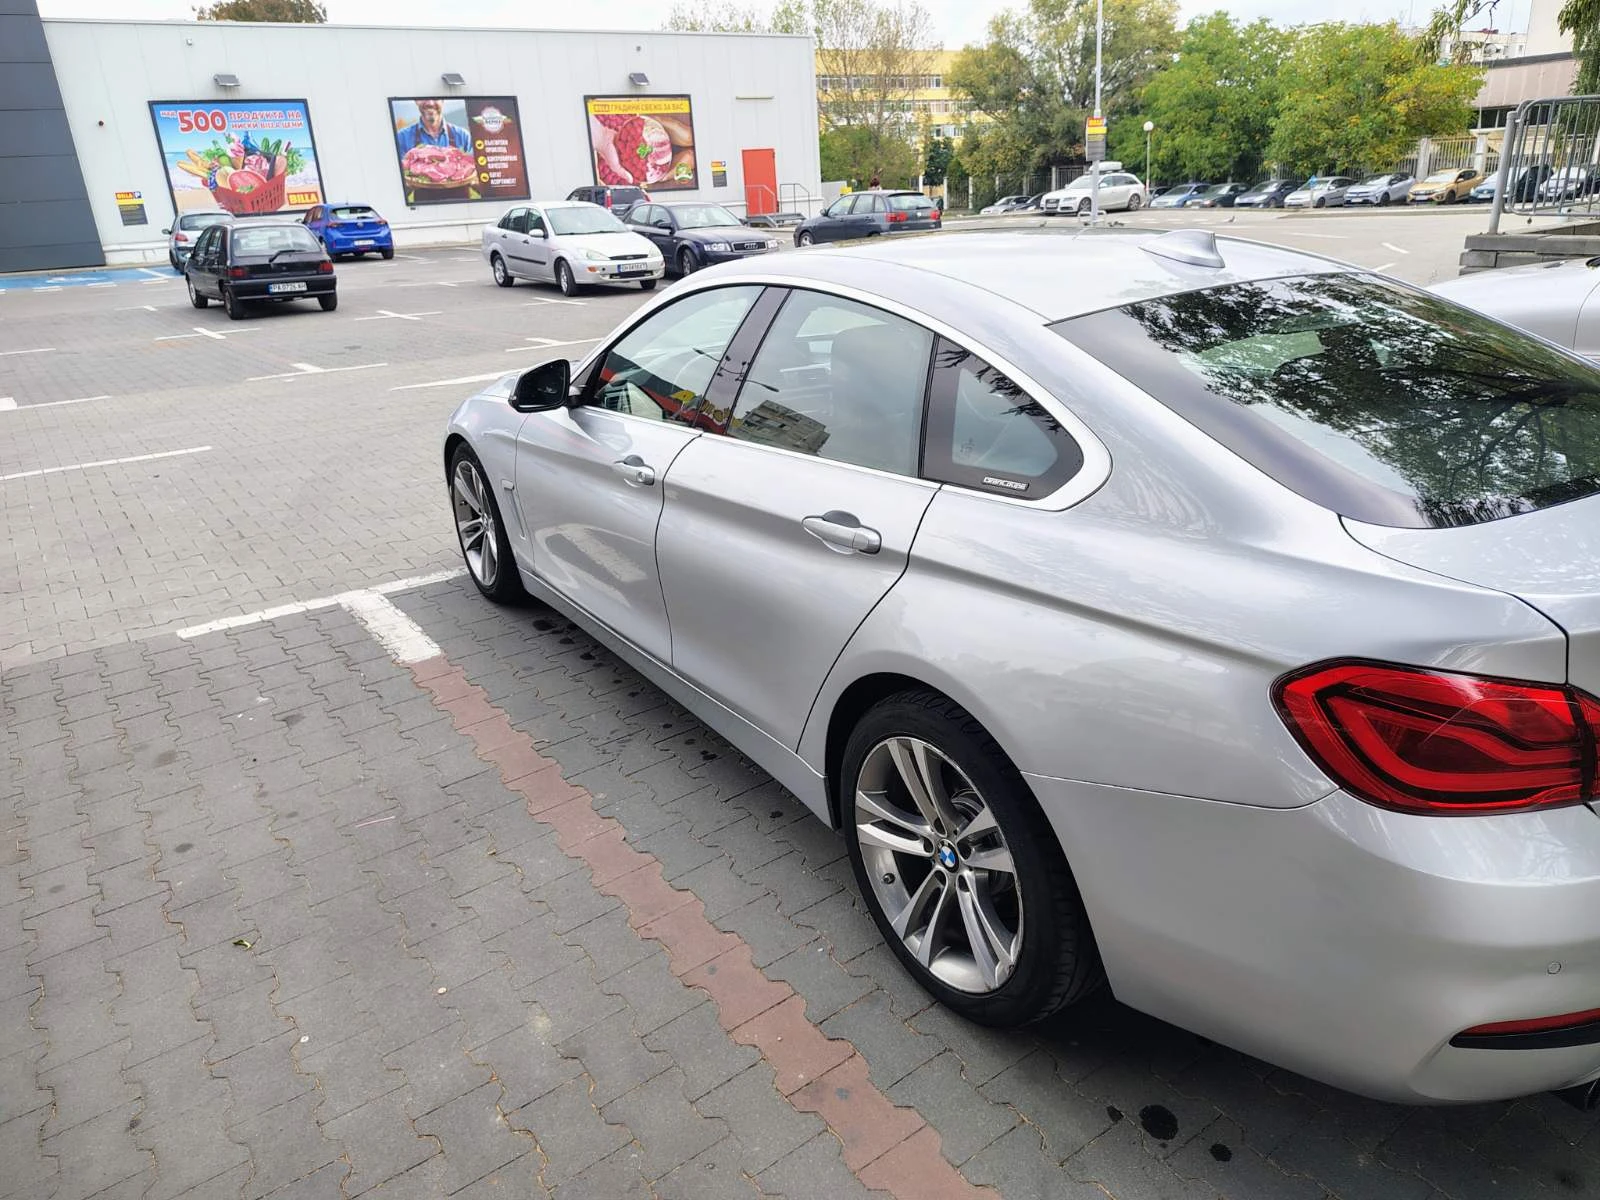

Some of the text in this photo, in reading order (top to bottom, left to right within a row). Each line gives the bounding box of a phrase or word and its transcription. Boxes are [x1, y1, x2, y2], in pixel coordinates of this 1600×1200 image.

[178, 110, 227, 132] 500
[229, 111, 284, 121] ПРОДУКТА
[287, 110, 303, 120] НА
[231, 121, 258, 129] НИСКИ
[282, 121, 303, 129] ЦЕНИ
[288, 192, 319, 204] BILLA
